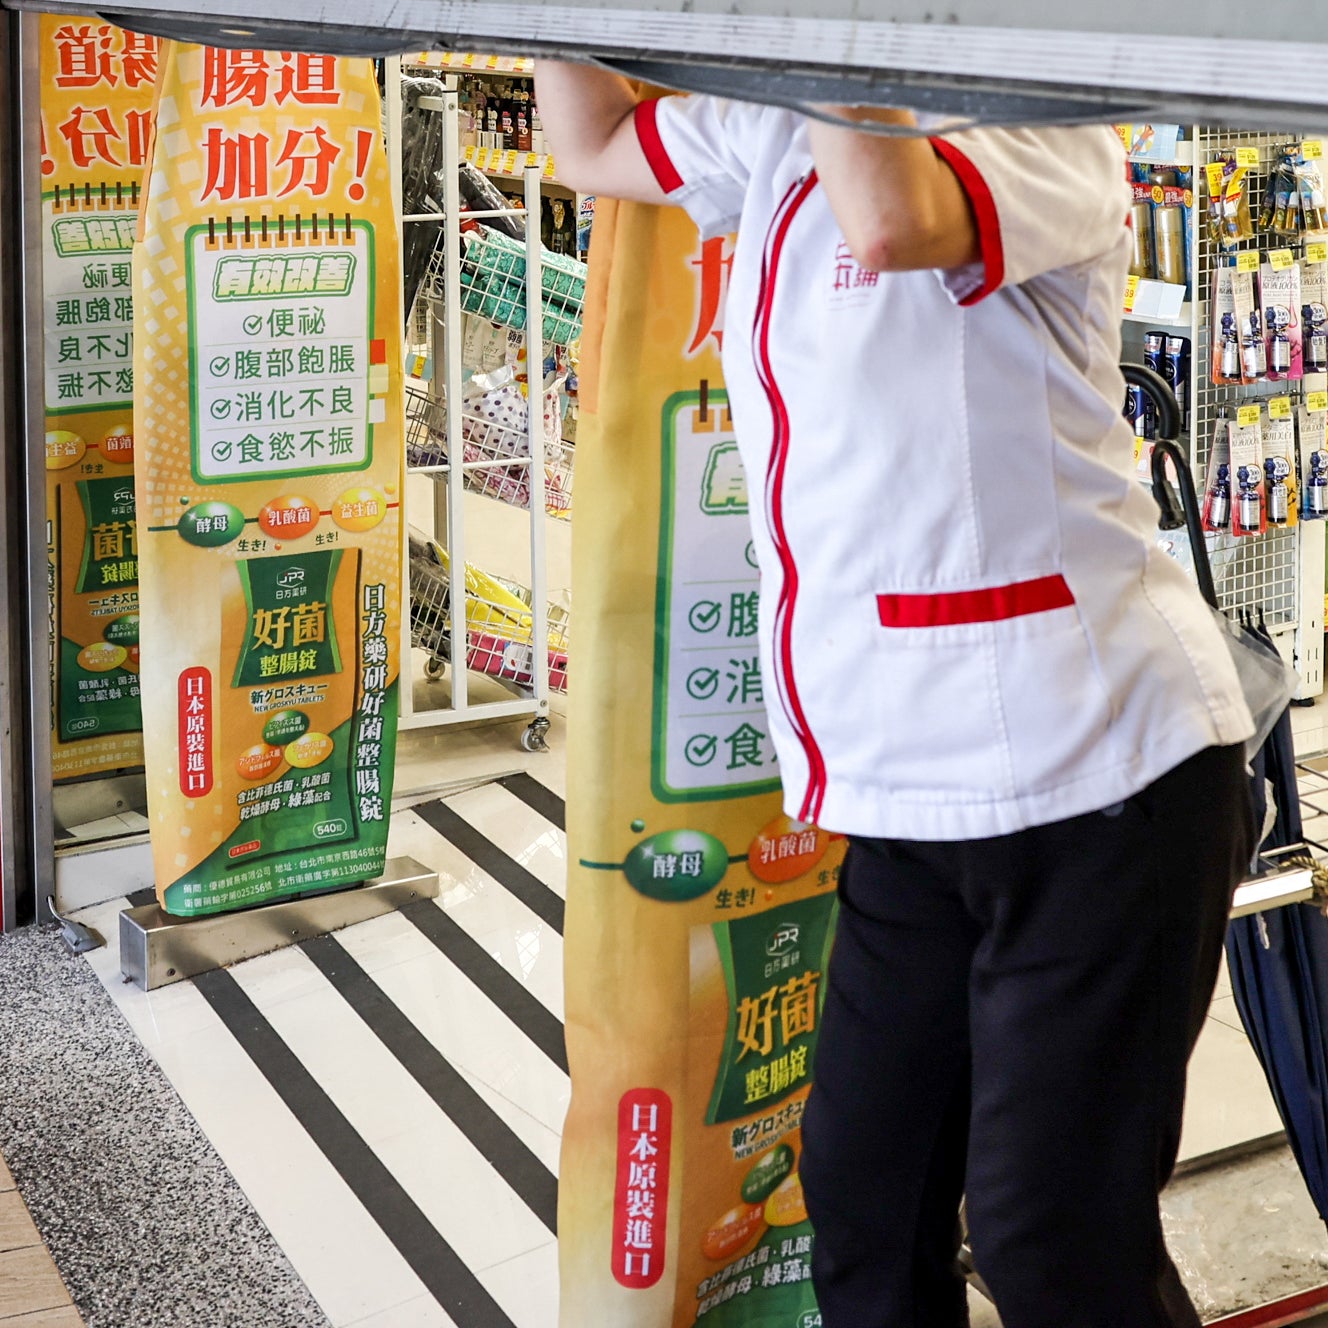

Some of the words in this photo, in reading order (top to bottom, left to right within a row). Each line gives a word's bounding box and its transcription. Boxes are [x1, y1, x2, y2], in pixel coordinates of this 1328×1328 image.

[201, 46, 341, 108] 腸道
[200, 126, 373, 201] 加分!
[234, 344, 355, 380] 腹部飽脹
[235, 385, 354, 422] 消化不良
[237, 426, 354, 464] 食慾不振
[196, 515, 229, 534] 酵母
[268, 508, 312, 527] 乳酸菌
[340, 500, 379, 520] 益生菌
[252, 600, 327, 651] 好菌
[259, 650, 318, 678] 整腸錠
[250, 682, 328, 706] 新グロスキュー
[356, 583, 387, 822] 日方藥研好菌整腸錠
[184, 675, 207, 791] 日本原裝進口
[653, 851, 703, 879] 酵母
[760, 831, 818, 865] 乳酸菌
[735, 970, 822, 1065] 好菌
[745, 1044, 808, 1105] 整腸錠
[623, 1104, 659, 1276] 日本原裝進口
